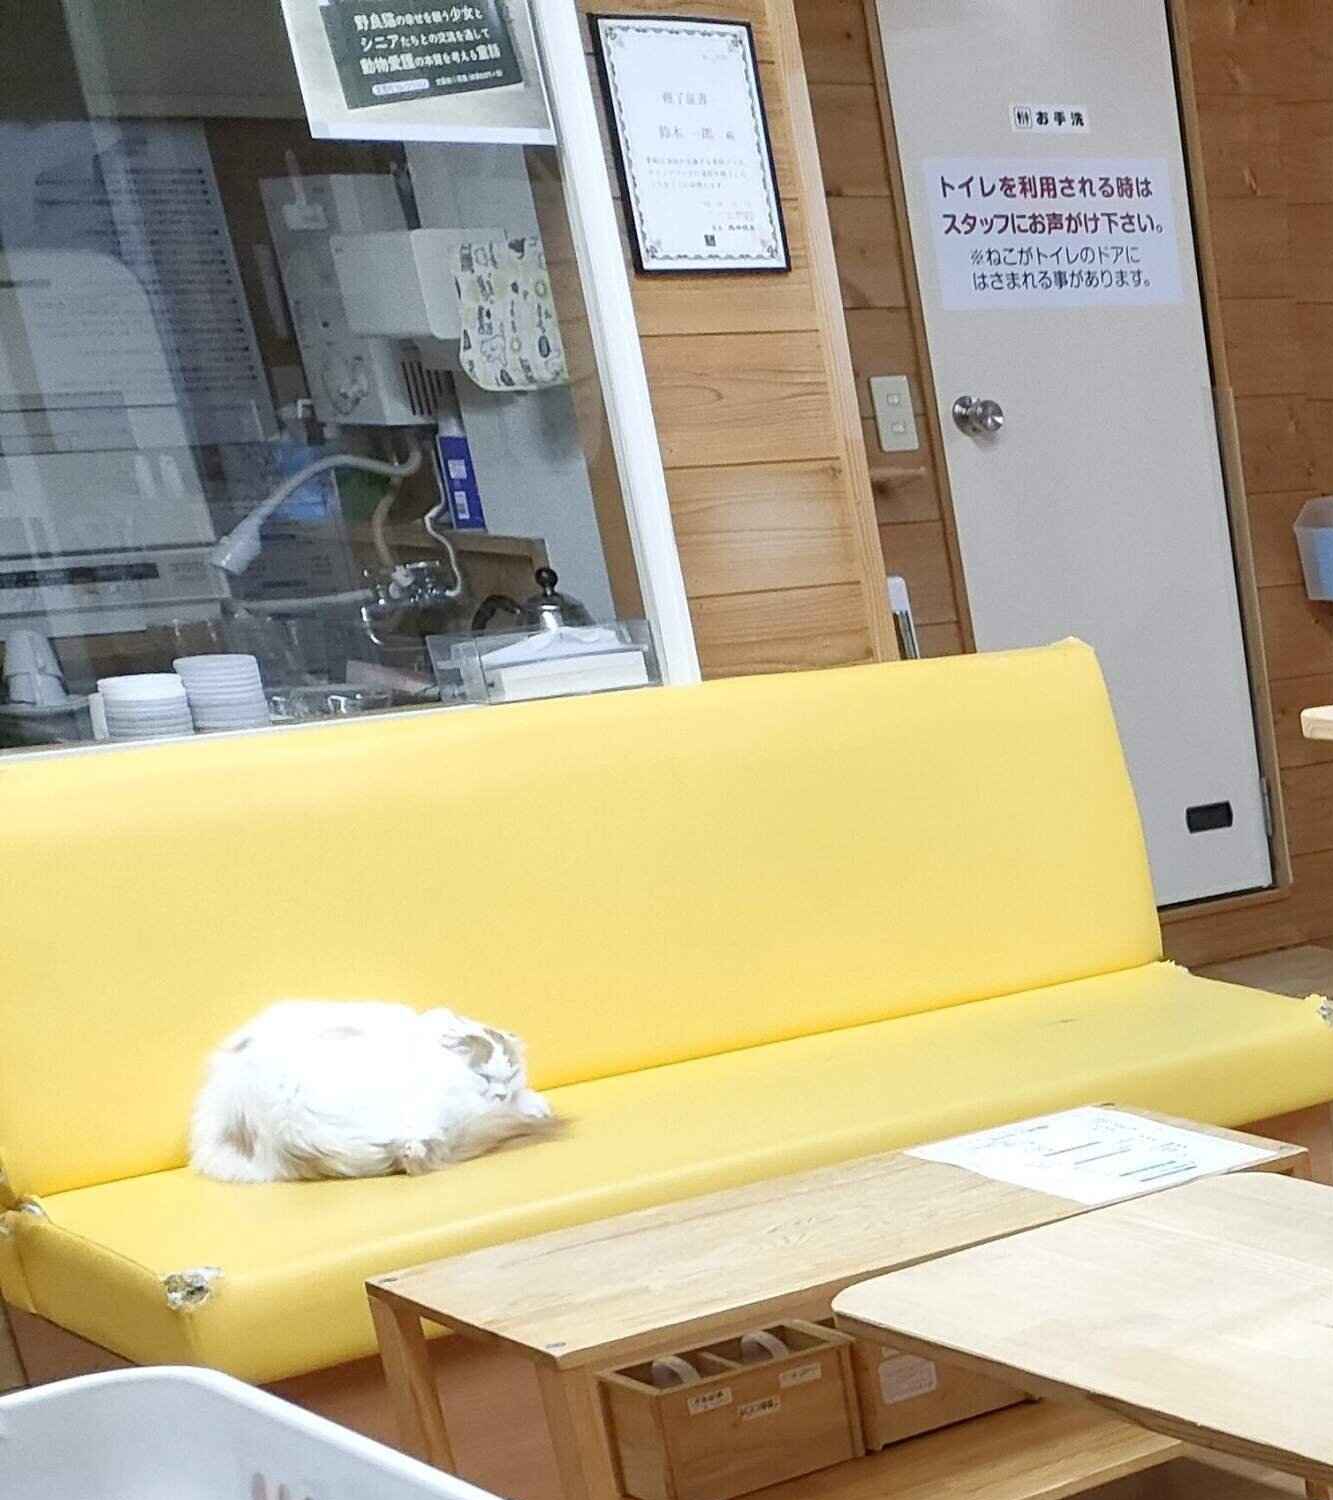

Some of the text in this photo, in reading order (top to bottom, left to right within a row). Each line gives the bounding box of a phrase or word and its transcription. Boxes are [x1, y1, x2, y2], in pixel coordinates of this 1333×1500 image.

[941, 175, 1153, 200] トイレを利用される時は
[942, 211, 1163, 236] スタッフにお声がけ下さい。
[972, 269, 1151, 292] はさまれる事があります。
